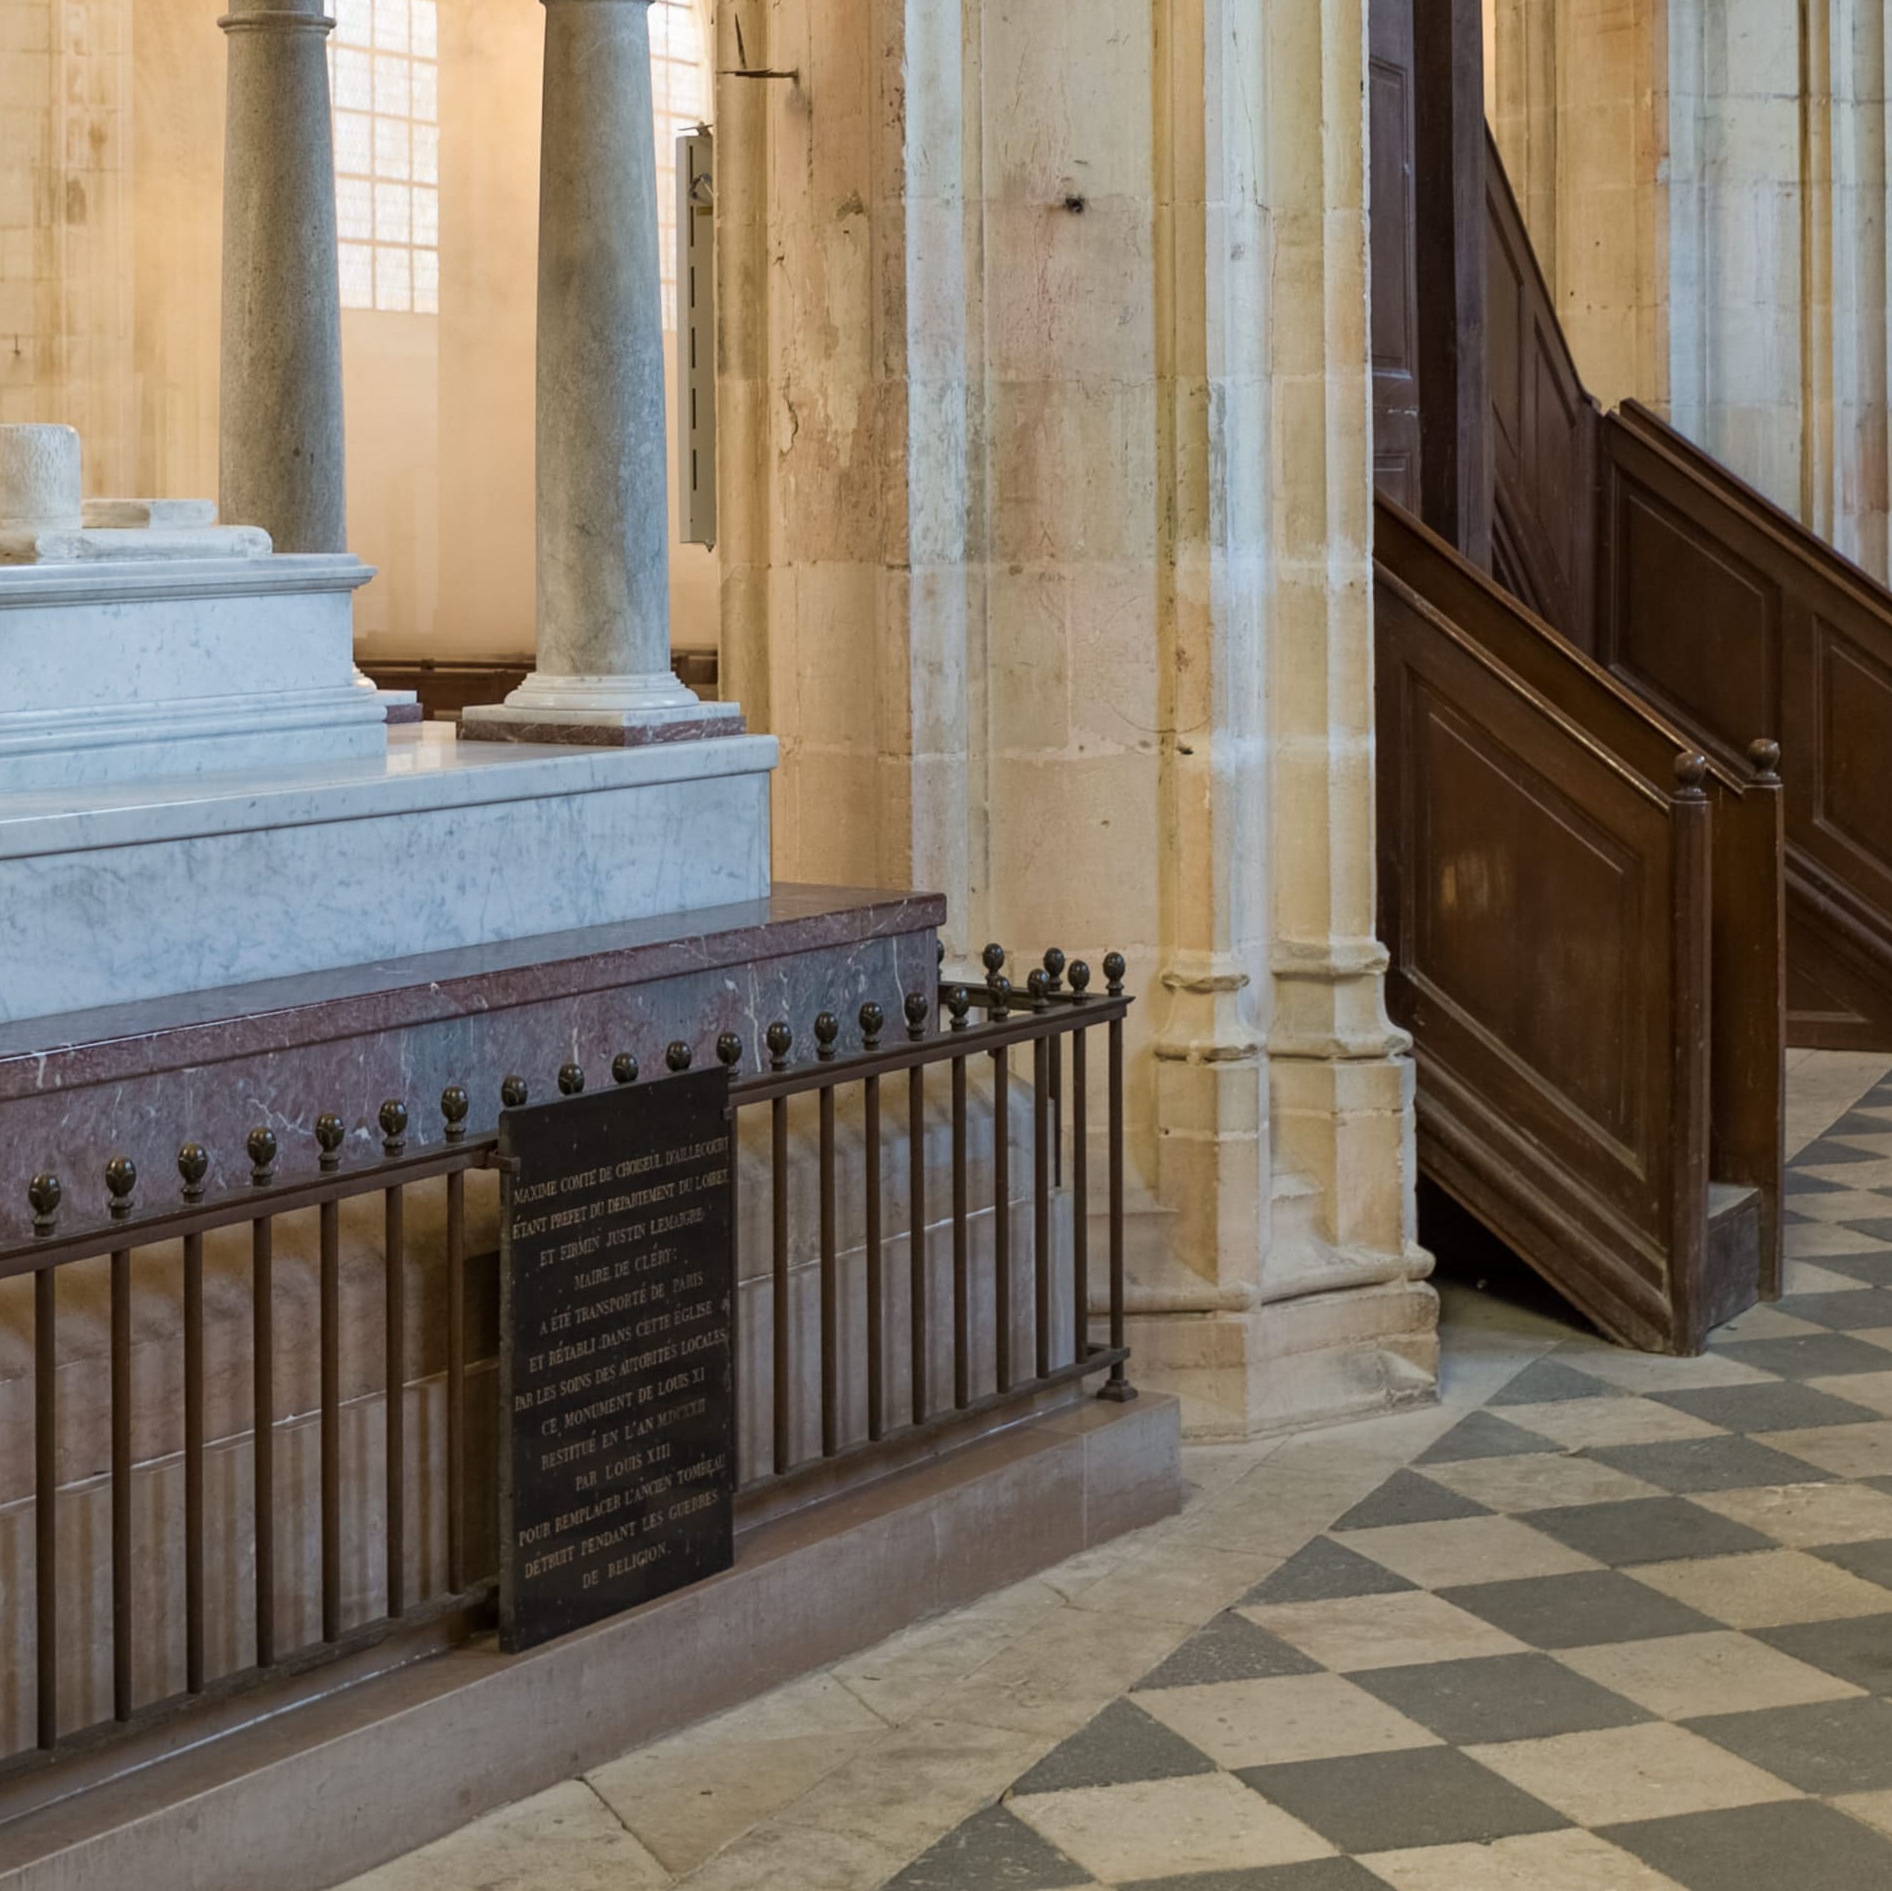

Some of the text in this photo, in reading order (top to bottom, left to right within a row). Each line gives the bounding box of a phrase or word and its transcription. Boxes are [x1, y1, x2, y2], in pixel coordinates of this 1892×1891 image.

[511, 1214, 547, 1239] ÉTANT
[550, 1205, 587, 1230] PREFET
[589, 1200, 604, 1219] DU
[607, 1182, 674, 1213] DEPARTEMENT
[678, 1177, 692, 1195] DU
[513, 1180, 557, 1204] MAXIME
[598, 1165, 612, 1183] DE
[539, 1248, 555, 1267] ET
[605, 1222, 645, 1247] JUSTIN
[574, 1266, 611, 1290] MAIRE
[614, 1259, 629, 1278] DE
[539, 1271, 703, 1334] A ÉTÉ TRANSPORTÉ DE PARIS
[528, 1300, 712, 1373] ET RÉTABLI DANS CETTE ÉGLISE
[514, 1328, 727, 1411] PAR LES SOINS DES AUTORITÉS LOCALES
[540, 1366, 704, 1436] CE MONUMENT DE LOUIS XI
[541, 1429, 595, 1470] RESTITUÉ
[601, 1429, 618, 1449] EN
[624, 1416, 653, 1440] L'AN
[575, 1442, 670, 1491] PAR LOUIS XIII
[518, 1521, 550, 1547] POUR
[554, 1494, 620, 1532] REMPLACER
[624, 1474, 671, 1505] L'ANCIEN
[524, 1489, 717, 1578] DÉTRUIT PENDANT LES GUERRES
[582, 1569, 599, 1589] DE
